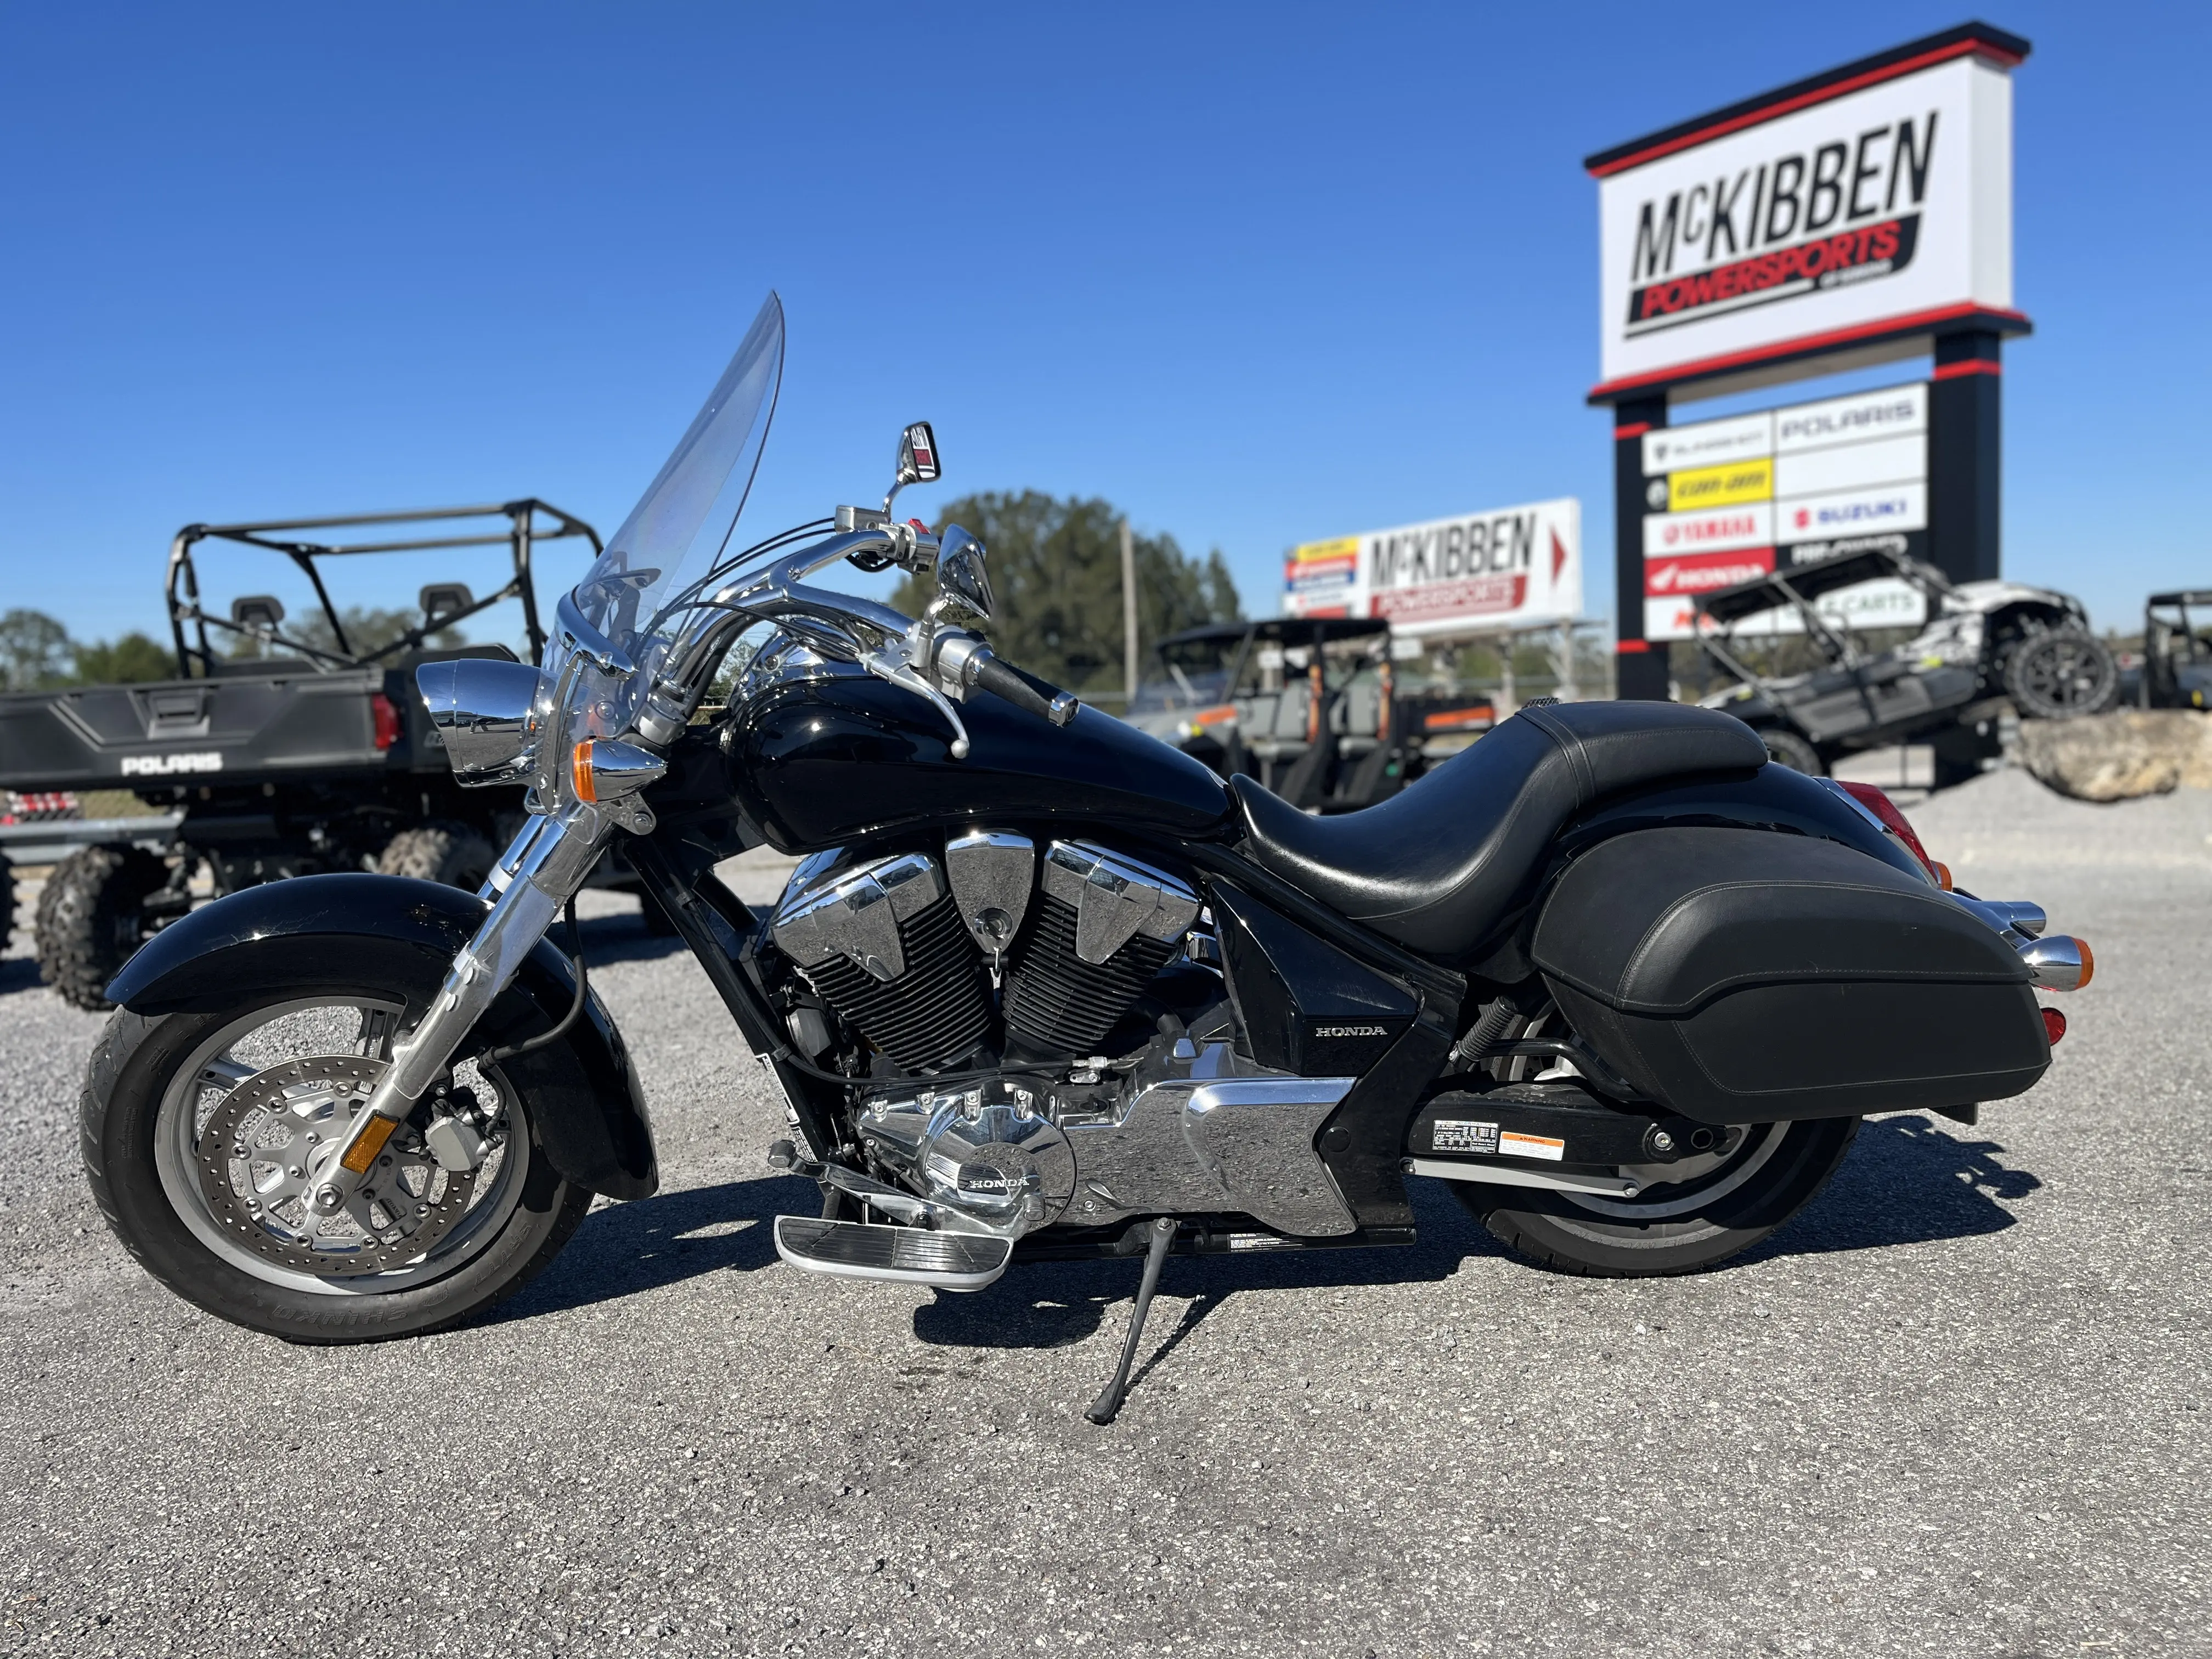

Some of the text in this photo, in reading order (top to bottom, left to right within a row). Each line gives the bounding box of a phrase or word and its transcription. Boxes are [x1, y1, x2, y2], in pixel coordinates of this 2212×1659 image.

[1640, 220, 1901, 318] POWERSPORTS
[1781, 399, 1915, 439] POLARIS
[1817, 498, 1907, 525] SUZUKI
[1675, 562, 1765, 589] HONDA
[1840, 590, 1916, 613] CARTS
[121, 752, 223, 776] POLARIS
[1316, 1026, 1388, 1036] HONDA
[969, 1178, 1030, 1189] HONDA
[272, 1305, 409, 1326] SHINKO
